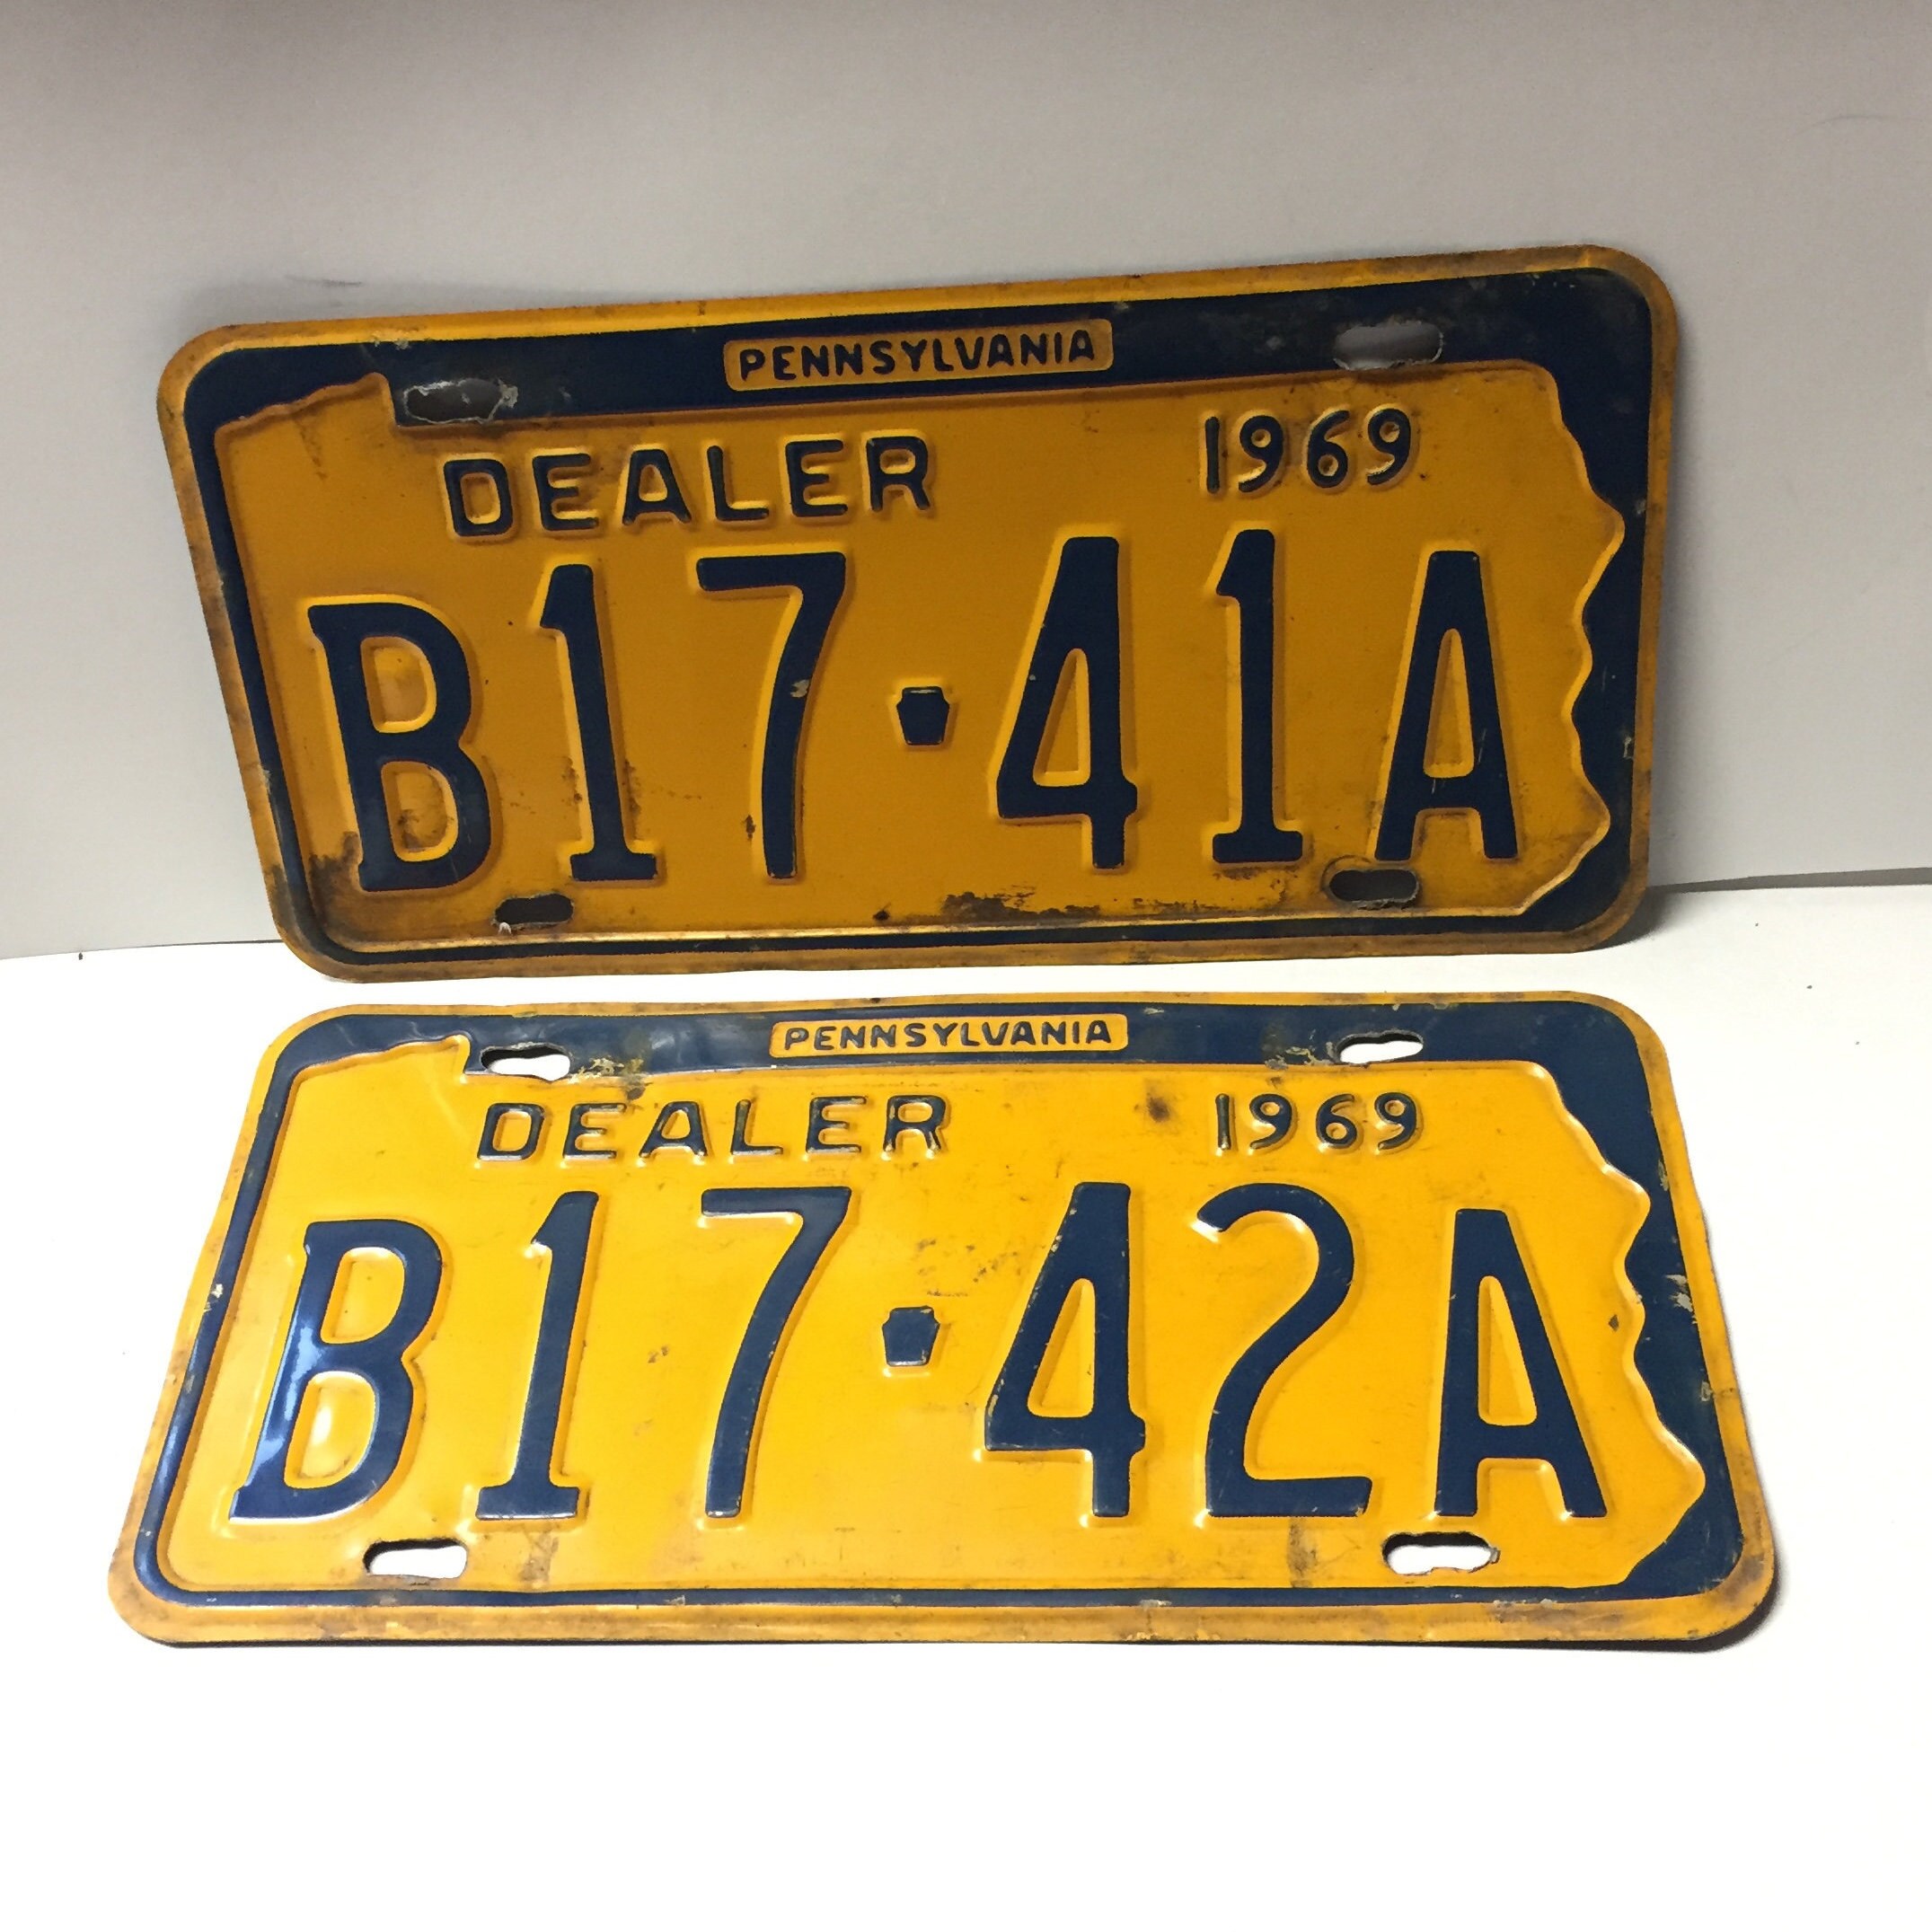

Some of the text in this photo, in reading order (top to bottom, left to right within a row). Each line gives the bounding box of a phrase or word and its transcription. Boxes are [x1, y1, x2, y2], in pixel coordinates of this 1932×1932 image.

[740, 330, 1095, 382] PENNSYLVANIA
[1204, 408, 1412, 494] 1969
[444, 436, 931, 537] DEALER
[785, 1019, 1111, 1052] PENNSYLVANIA
[477, 1095, 948, 1161] DEALER
[1215, 1092, 1418, 1151] 1969
